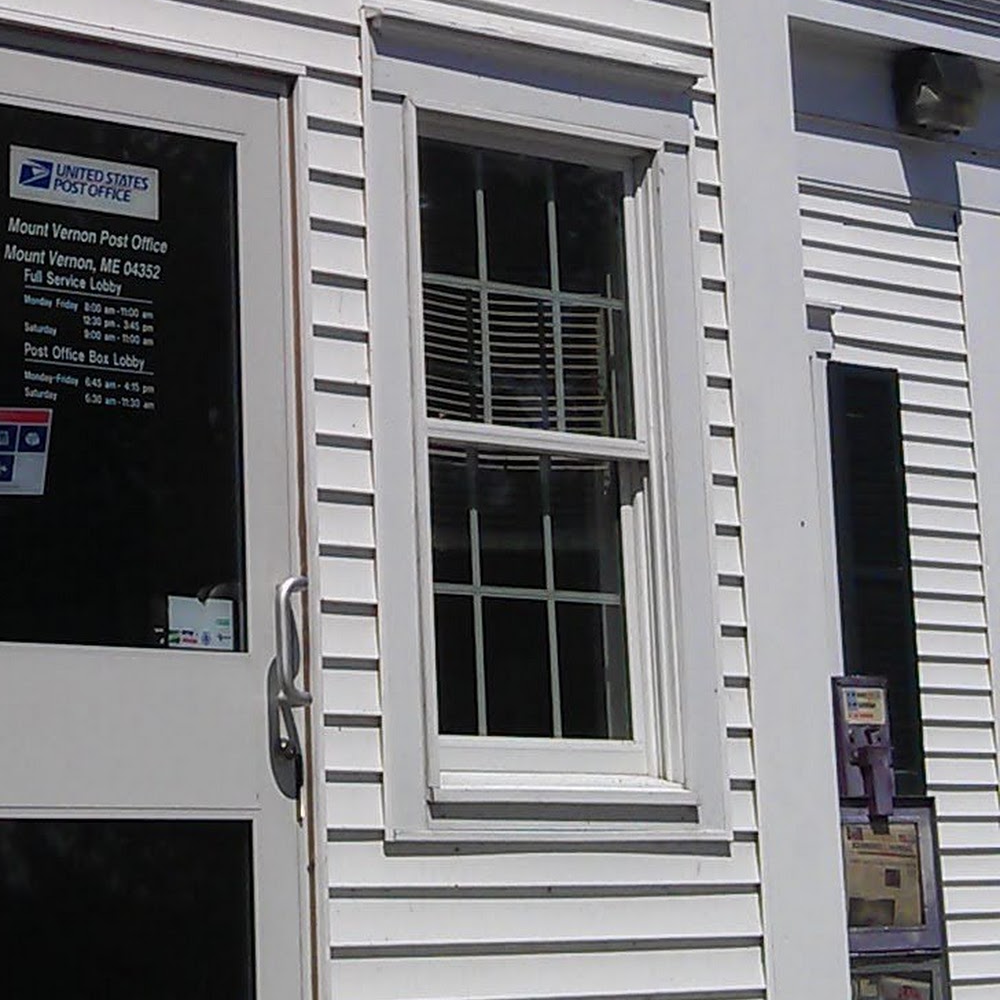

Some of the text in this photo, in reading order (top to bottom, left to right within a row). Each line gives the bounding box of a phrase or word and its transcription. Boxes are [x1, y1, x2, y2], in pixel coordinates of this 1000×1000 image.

[53, 179, 132, 202] POST OFFICE
[56, 163, 149, 191] UNITED STATES
[7, 217, 168, 254] Mount Vernon Post Office
[3, 244, 161, 280] Mount Vernon, ME 04352
[23, 268, 122, 297] Full Service Lobby
[24, 321, 57, 337] Saturday
[23, 342, 146, 371] Post Office Box Lobby
[24, 387, 58, 402] Saturday
